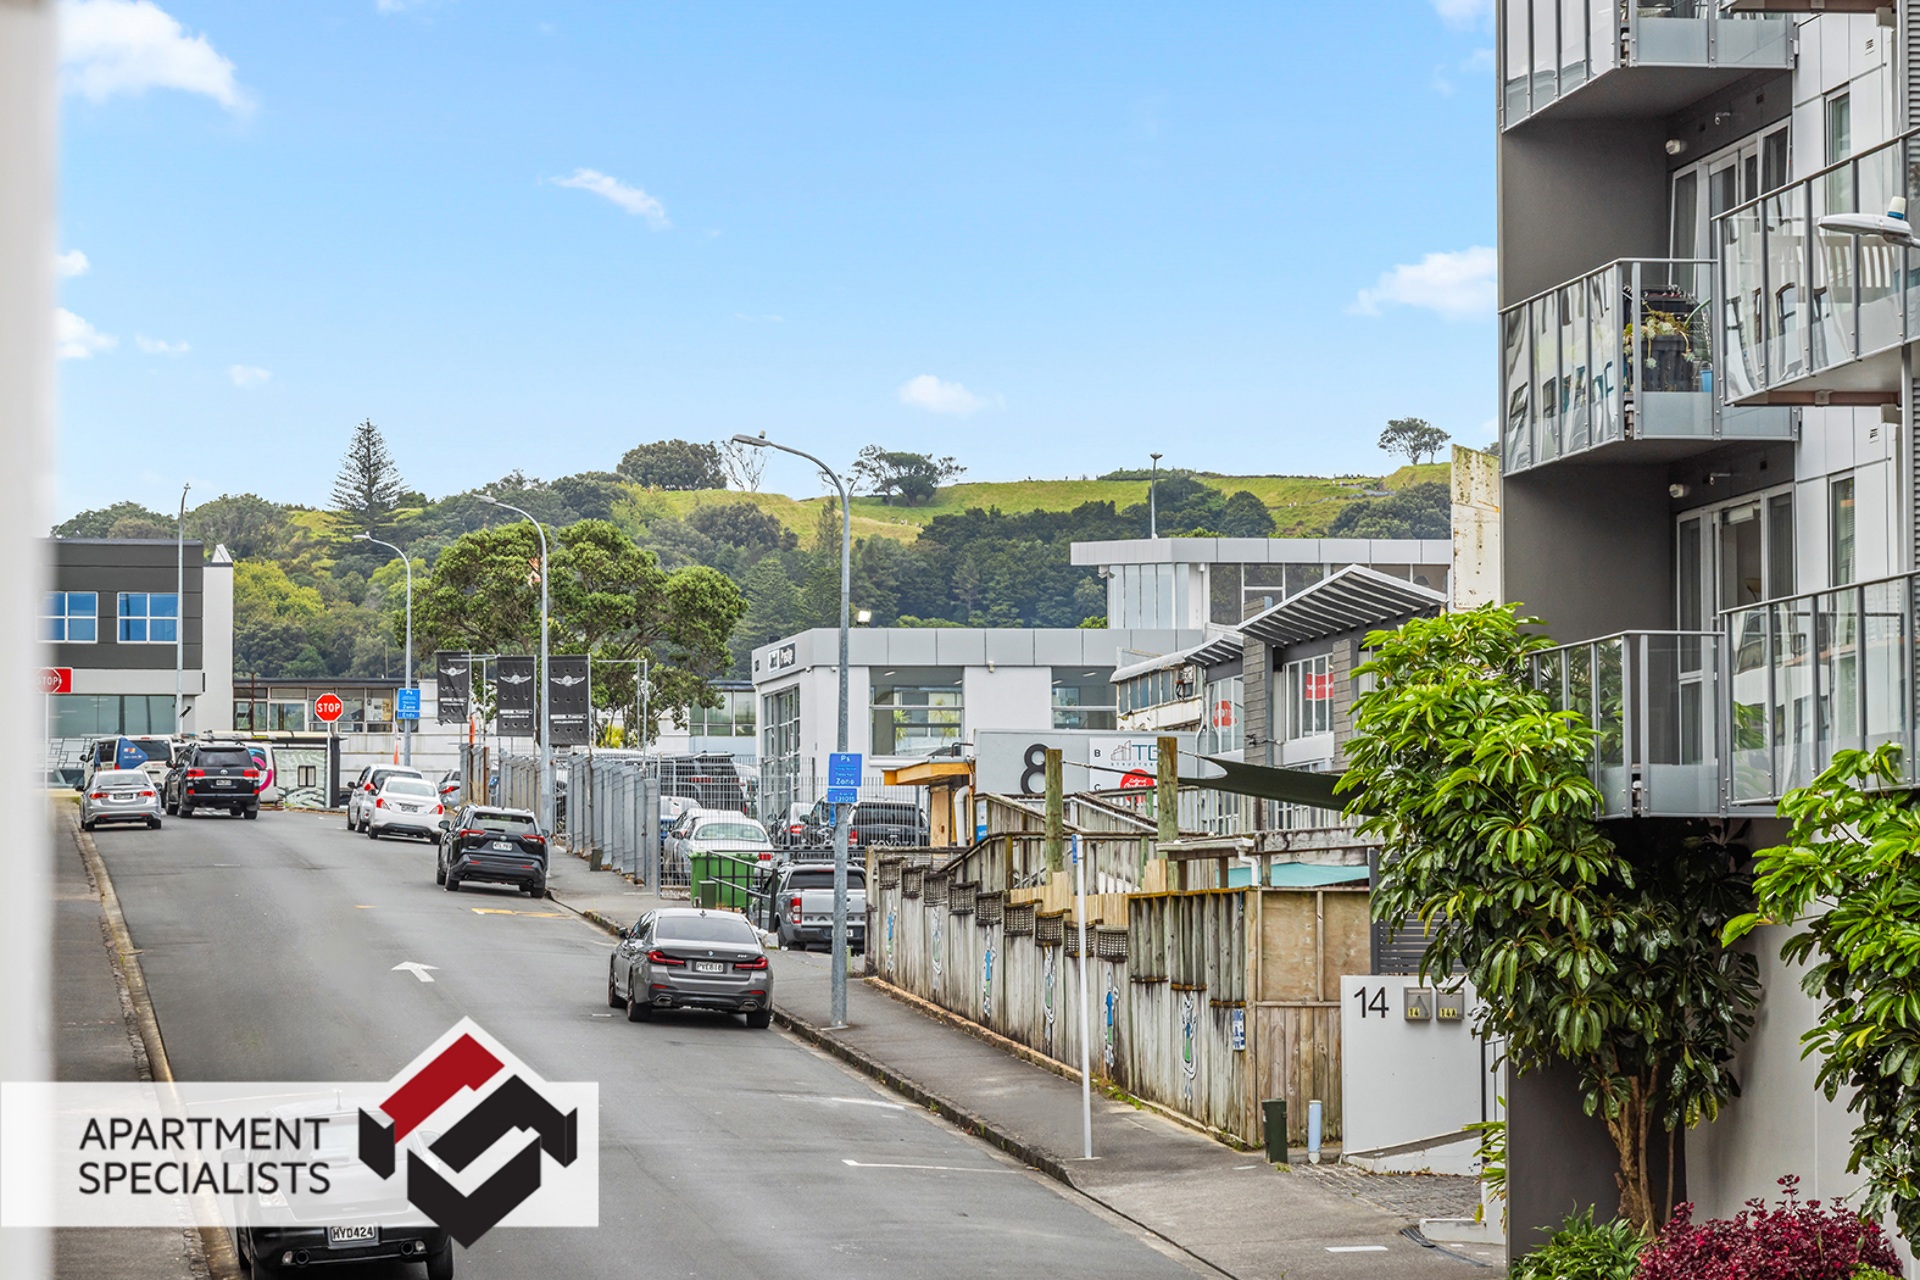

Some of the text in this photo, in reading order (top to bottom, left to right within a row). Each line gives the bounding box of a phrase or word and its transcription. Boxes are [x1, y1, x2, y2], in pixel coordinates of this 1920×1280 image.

[317, 702, 341, 713] STOP
[1093, 749, 1101, 757] B
[1020, 743, 1047, 794] 8
[835, 777, 855, 785] Zone
[1354, 986, 1390, 1018] 14
[1409, 1008, 1419, 1016] 14
[1440, 1008, 1456, 1017] 14A
[332, 1226, 374, 1239] HYD424
